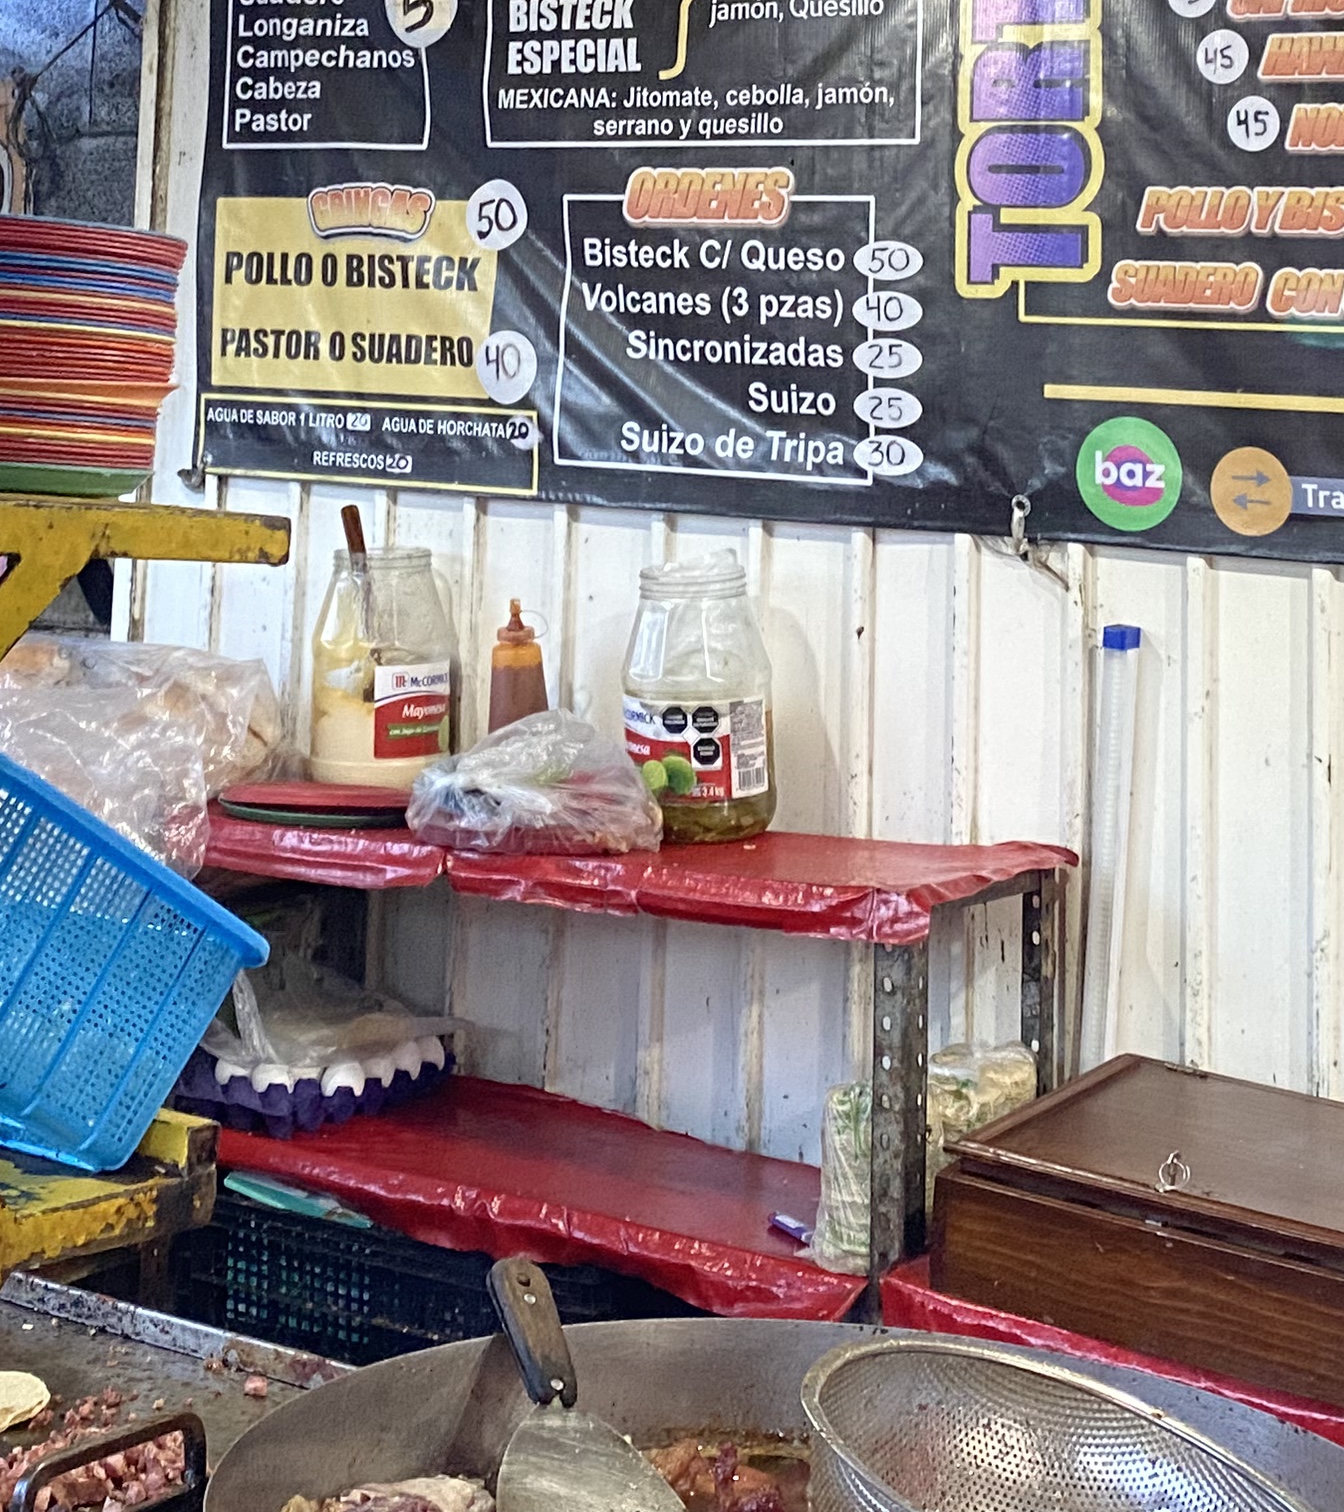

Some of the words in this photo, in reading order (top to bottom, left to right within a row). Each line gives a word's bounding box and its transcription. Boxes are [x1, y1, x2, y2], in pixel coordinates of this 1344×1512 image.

[238, 13, 369, 41] Longaniza
[236, 45, 415, 72] Campechanos
[507, 37, 642, 75] ESPECIAL
[1205, 45, 1233, 75] 45
[235, 76, 321, 100] Cabeza
[498, 89, 617, 110] MEXICANA:
[623, 85, 719, 110] Jitomate,
[725, 83, 810, 108] cebolla,
[815, 82, 895, 110] jamón,
[234, 108, 312, 132] Pastor
[593, 118, 674, 136] serrano
[679, 119, 691, 140] y
[698, 113, 784, 141] quesillo
[1236, 110, 1269, 140] 45
[624, 168, 792, 223] ORDENES
[1138, 188, 1249, 233] POLLO
[1250, 189, 1283, 233] Y
[477, 197, 517, 239] 50
[224, 251, 313, 287] POLLO
[345, 254, 481, 292] BISTECK
[583, 238, 690, 269] Bisteck
[699, 239, 733, 270] C/
[741, 241, 845, 272] Queso
[869, 247, 911, 274] 50
[1110, 262, 1260, 308] SUADERO
[582, 282, 712, 317] Volcanes
[721, 286, 750, 325] (3
[759, 289, 844, 327] pzas)
[866, 296, 904, 322] 40
[220, 328, 320, 361] PASTOR
[352, 333, 474, 368] SUADERO
[485, 343, 521, 381] 40
[625, 330, 844, 368] Sincronizadas
[868, 343, 904, 370] 25
[207, 407, 239, 424] AGUA
[240, 408, 254, 424] DE
[256, 409, 296, 426] SABOR
[299, 412, 306, 426] 1
[309, 412, 345, 429] LITRO
[748, 382, 836, 416] Suizo
[869, 395, 904, 421] 25
[382, 416, 417, 434] AGUA
[418, 418, 434, 434] DE
[438, 420, 506, 439] HORCHATA
[620, 421, 705, 455] Suizo
[715, 428, 754, 460] de
[765, 430, 844, 470] Tripa
[869, 440, 905, 466] 30
[313, 450, 385, 471] REFRESCOS
[1094, 450, 1167, 490] baz
